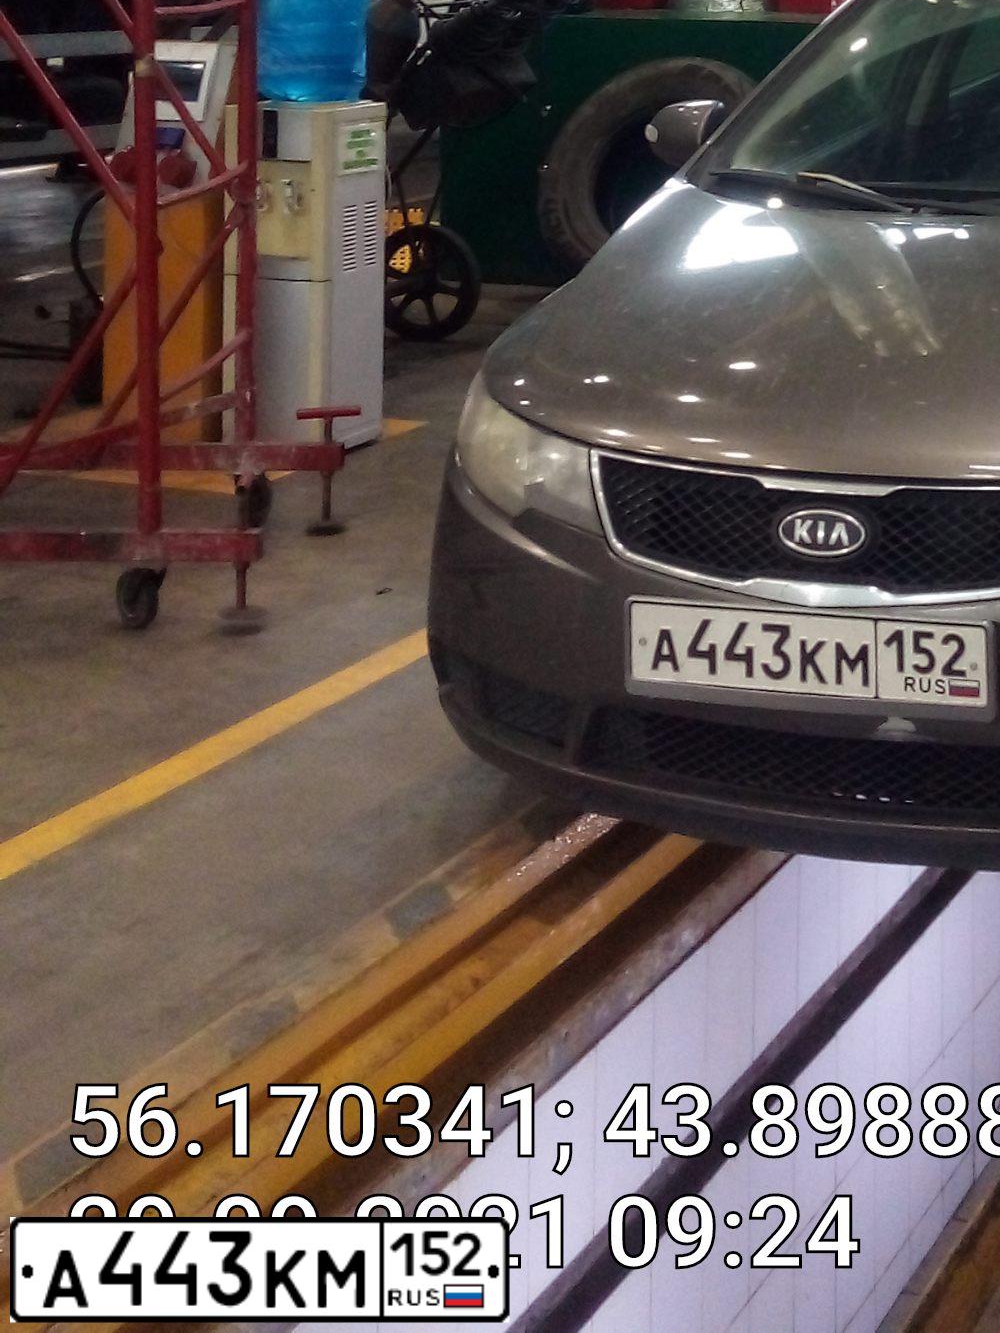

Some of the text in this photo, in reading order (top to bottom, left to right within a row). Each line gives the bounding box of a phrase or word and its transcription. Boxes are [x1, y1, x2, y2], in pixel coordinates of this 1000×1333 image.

[793, 518, 849, 547] KIA
[884, 629, 967, 678] 152
[904, 677, 946, 695] RUS
